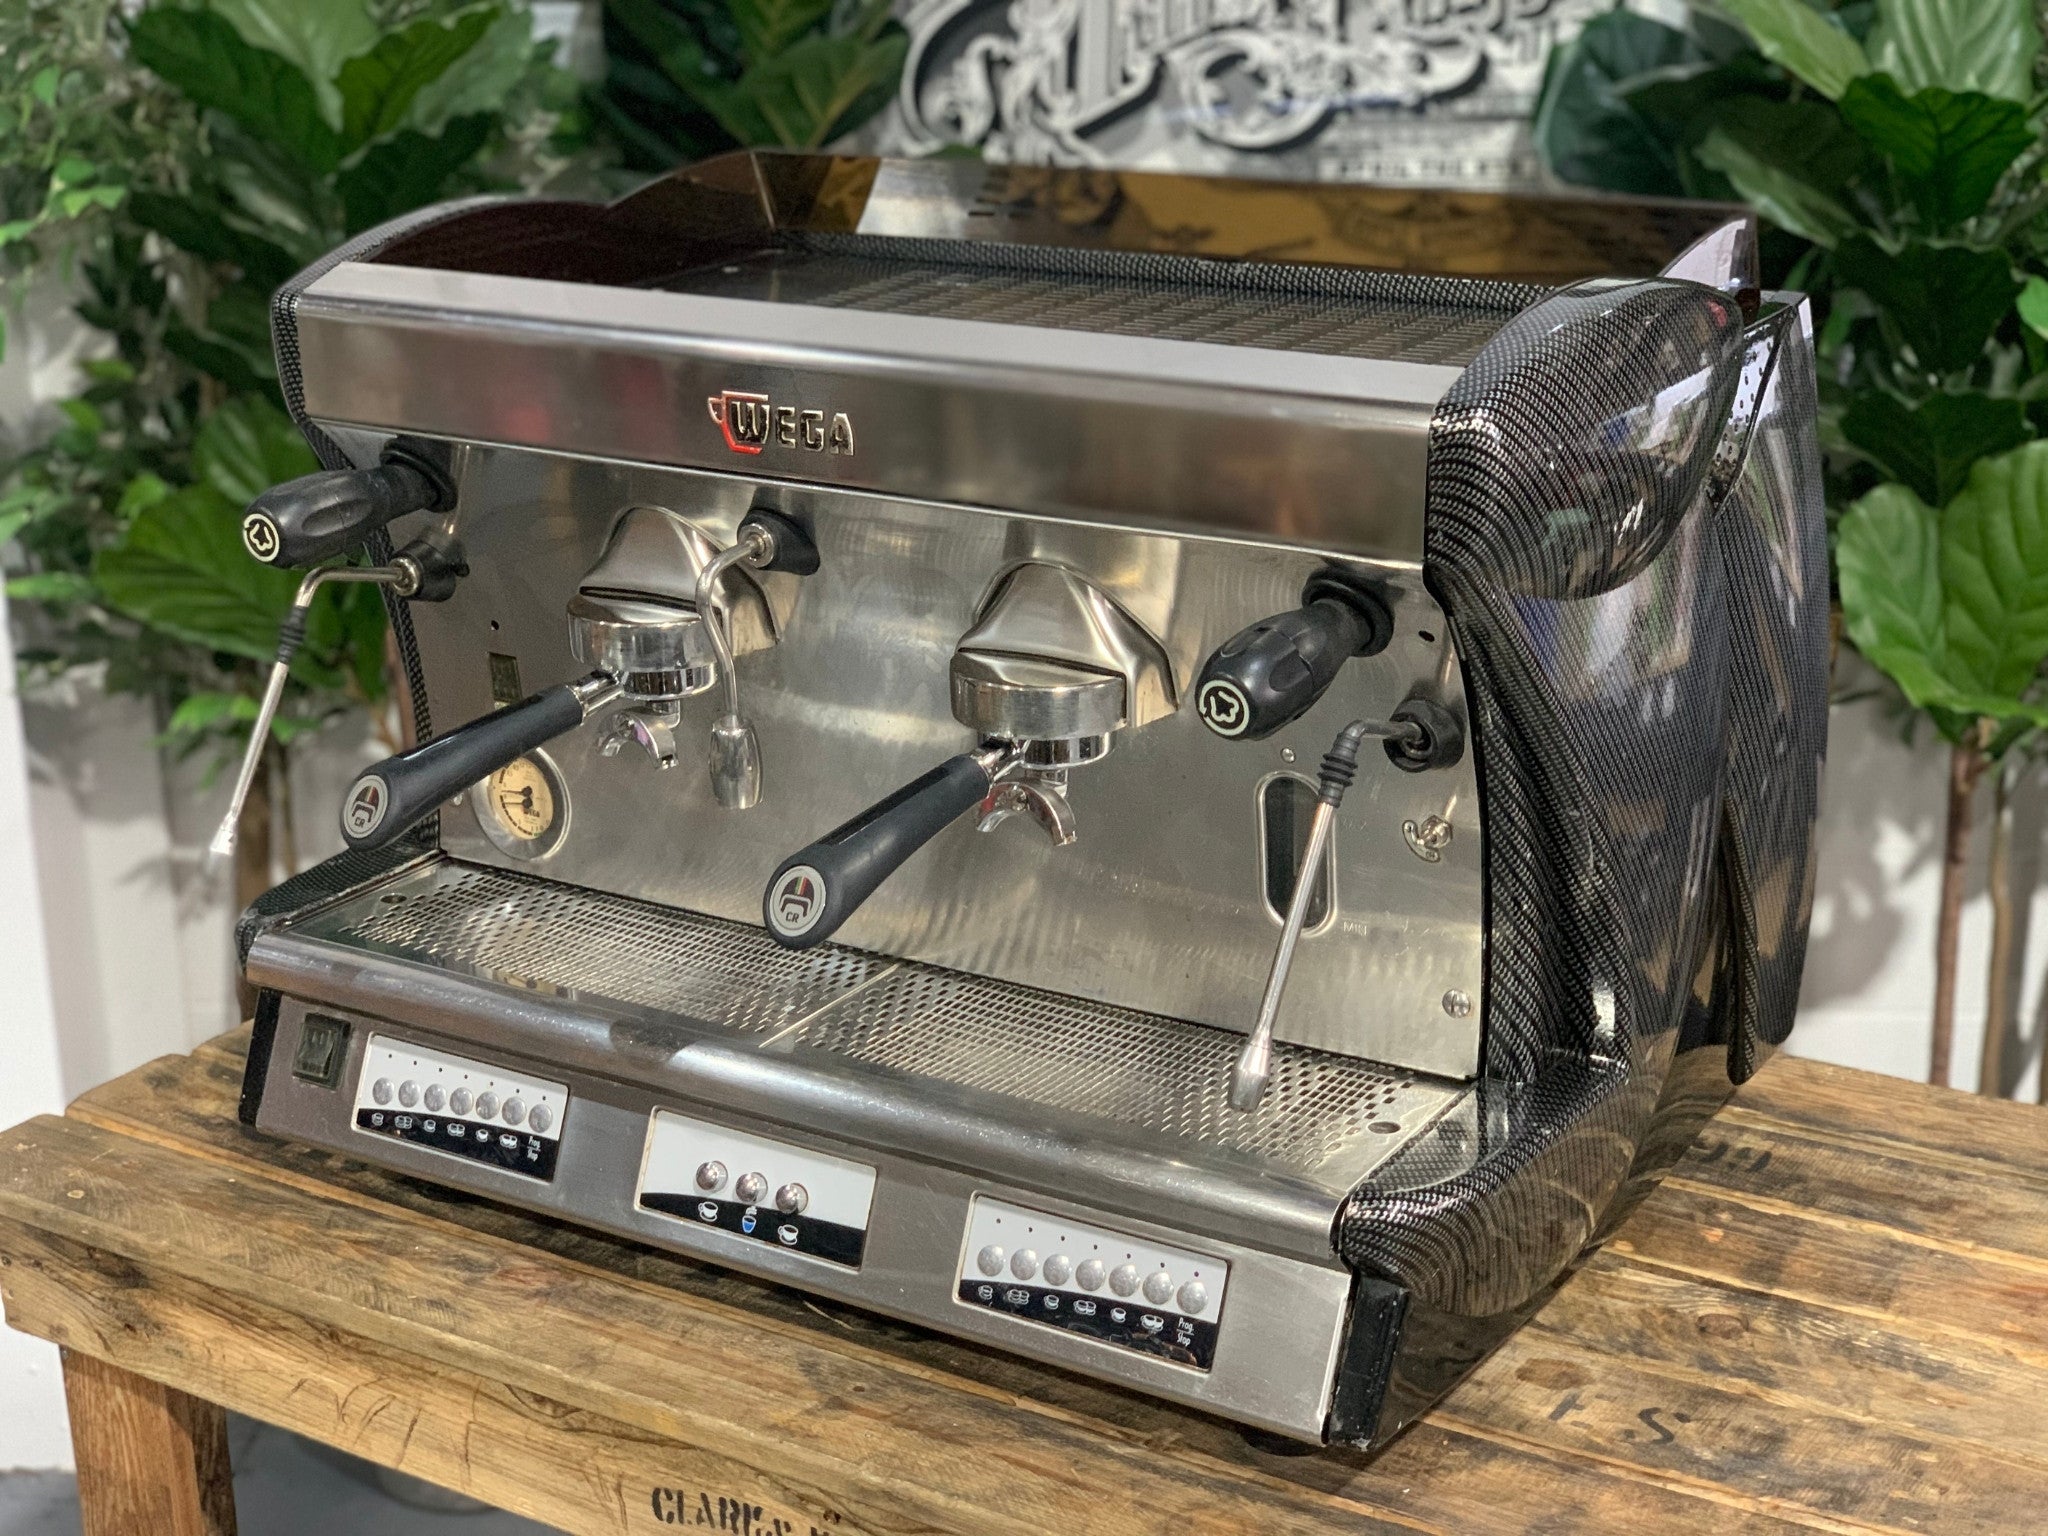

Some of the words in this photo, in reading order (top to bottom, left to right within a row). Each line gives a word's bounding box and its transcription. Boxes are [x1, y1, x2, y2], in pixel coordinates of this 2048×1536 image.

[730, 400, 854, 456] WEGA
[354, 816, 366, 828] CR
[785, 911, 800, 923] CR
[1176, 1331, 1192, 1347] Stop
